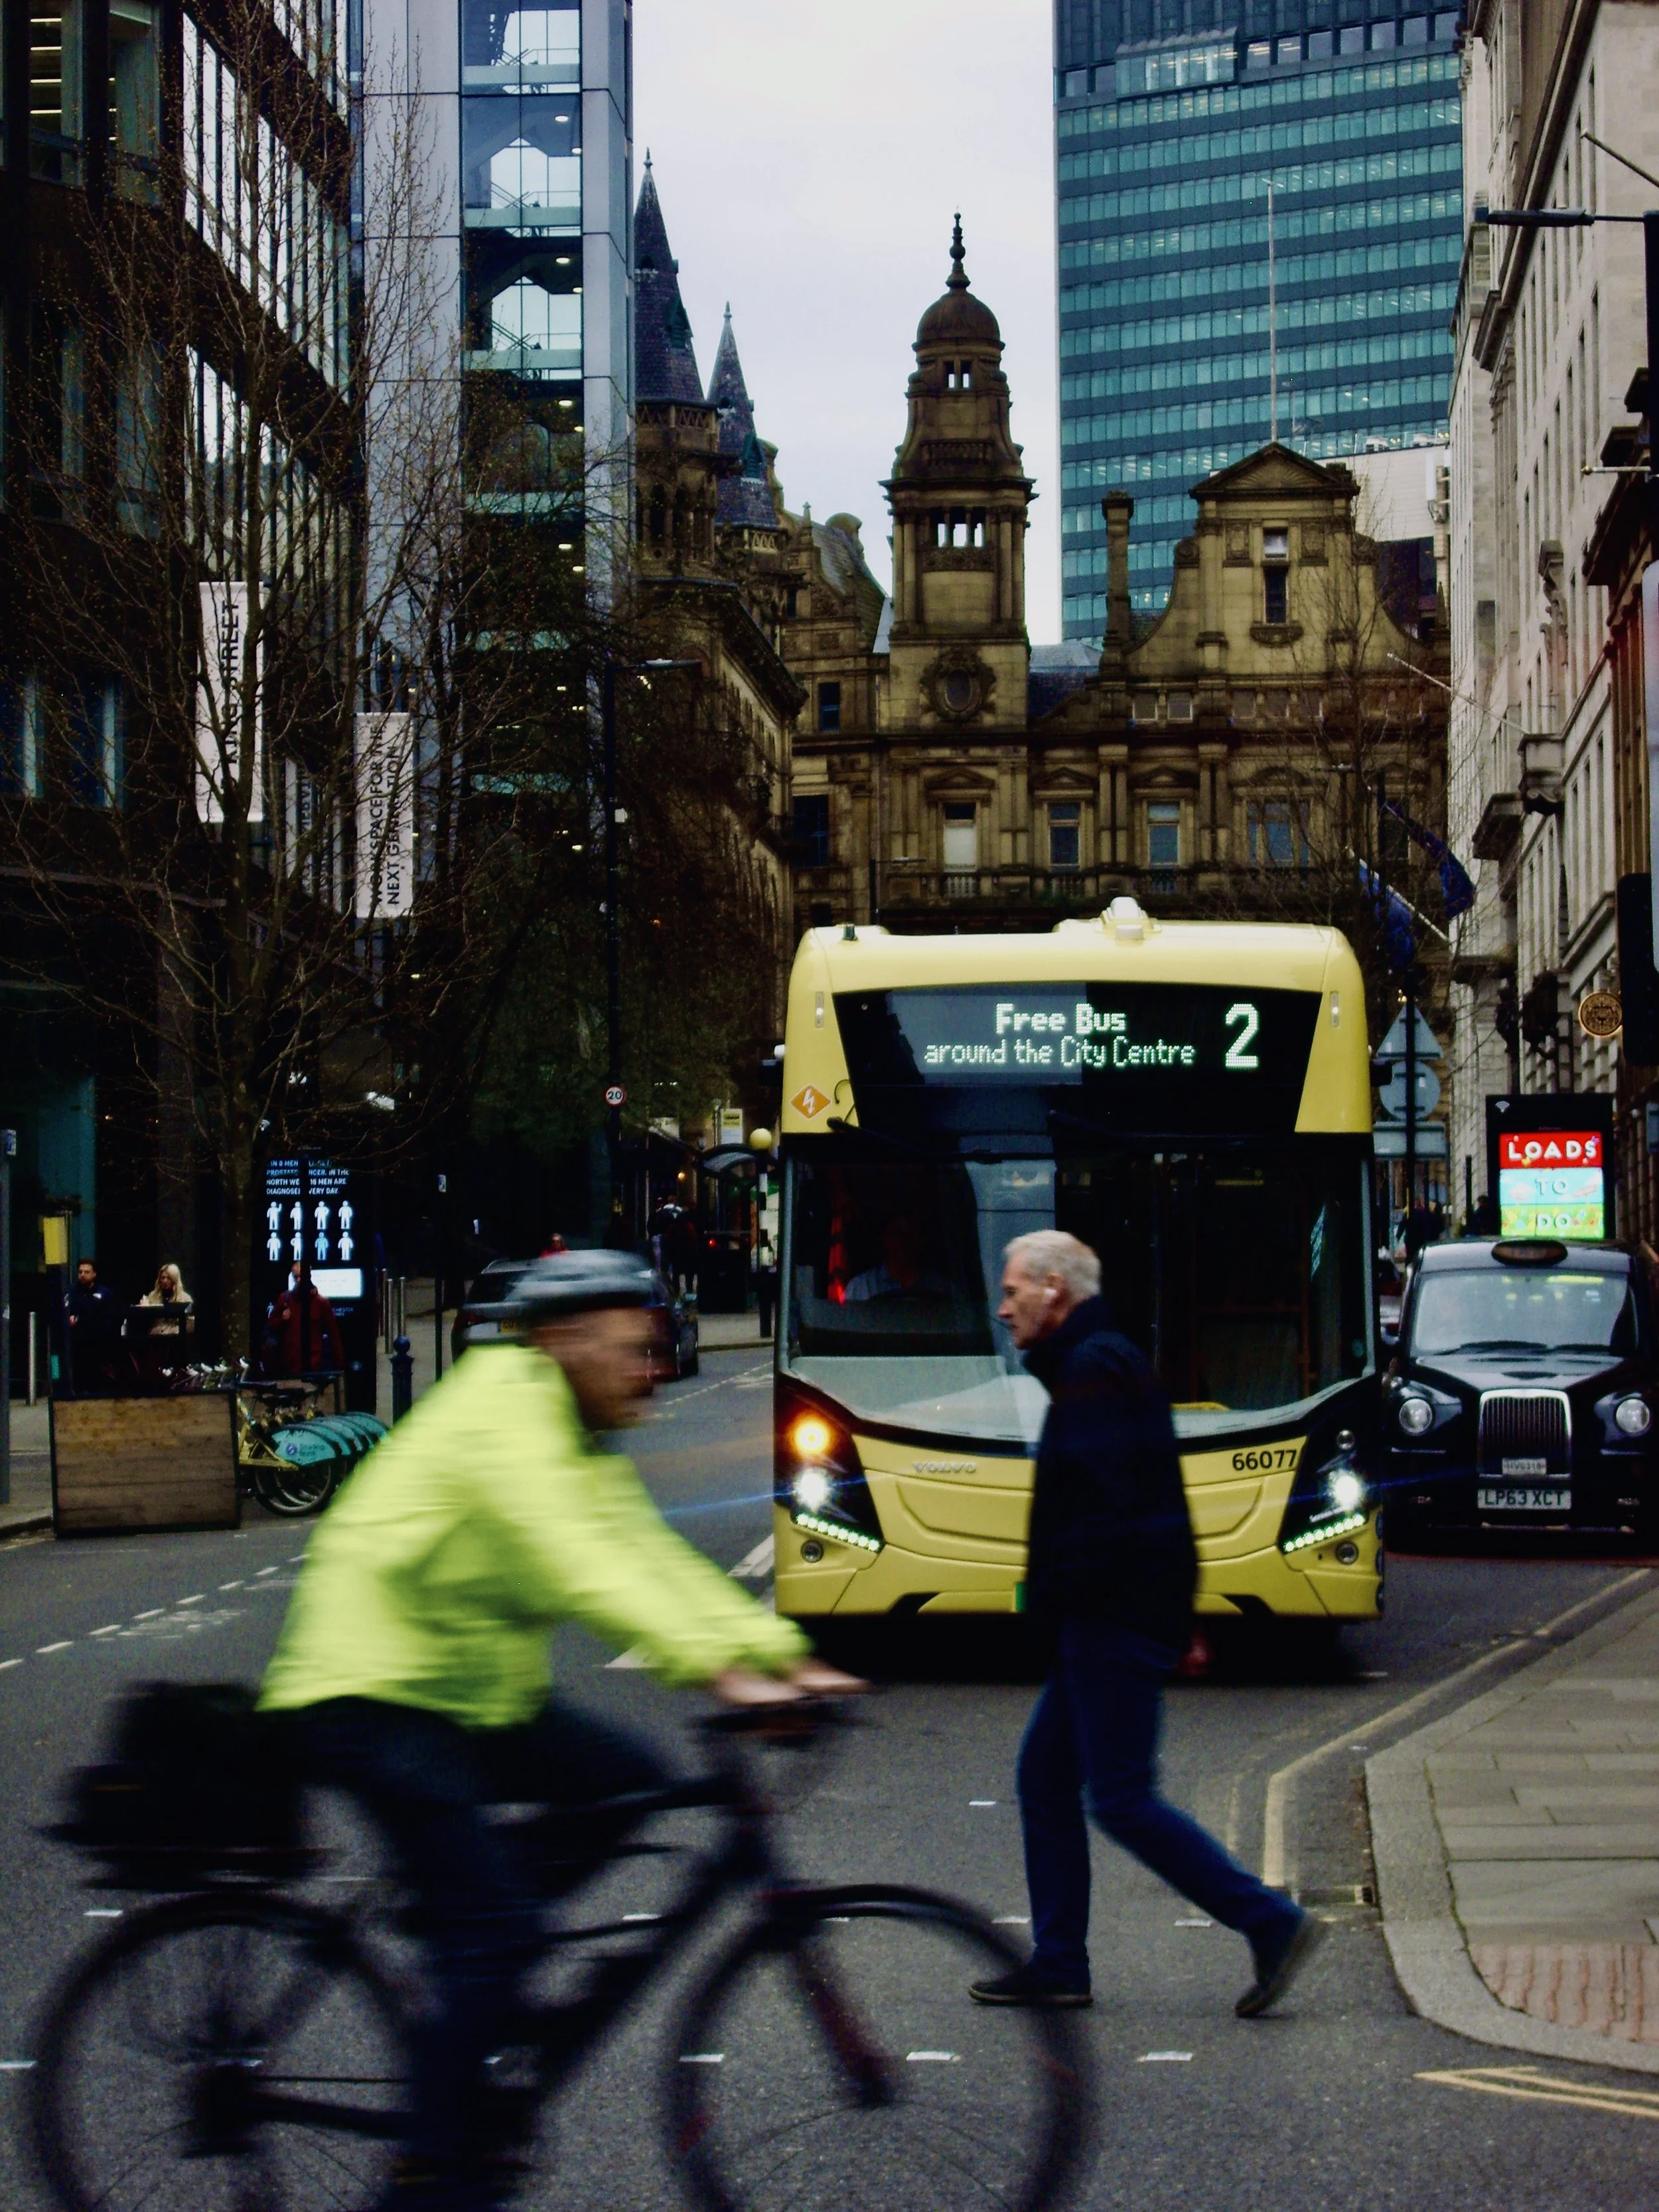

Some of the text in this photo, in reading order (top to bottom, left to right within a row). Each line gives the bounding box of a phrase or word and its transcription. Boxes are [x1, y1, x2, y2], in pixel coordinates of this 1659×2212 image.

[220, 600, 239, 691] STREET
[370, 762, 382, 794] FOR
[386, 746, 399, 905] NEXT GENTION
[995, 1002, 1127, 1034] Free Bus
[1224, 1003, 1260, 1070] 2
[924, 1036, 1196, 1067] around the City Centre
[607, 1091, 622, 1099] 20
[1507, 1140, 1596, 1161] LOADS
[1535, 1178, 1569, 1196] TO
[1536, 1213, 1572, 1231] DO
[912, 1460, 977, 1474] VOLVO
[1232, 1450, 1297, 1471] 66077
[1484, 1489, 1565, 1506] LP63 XCT
